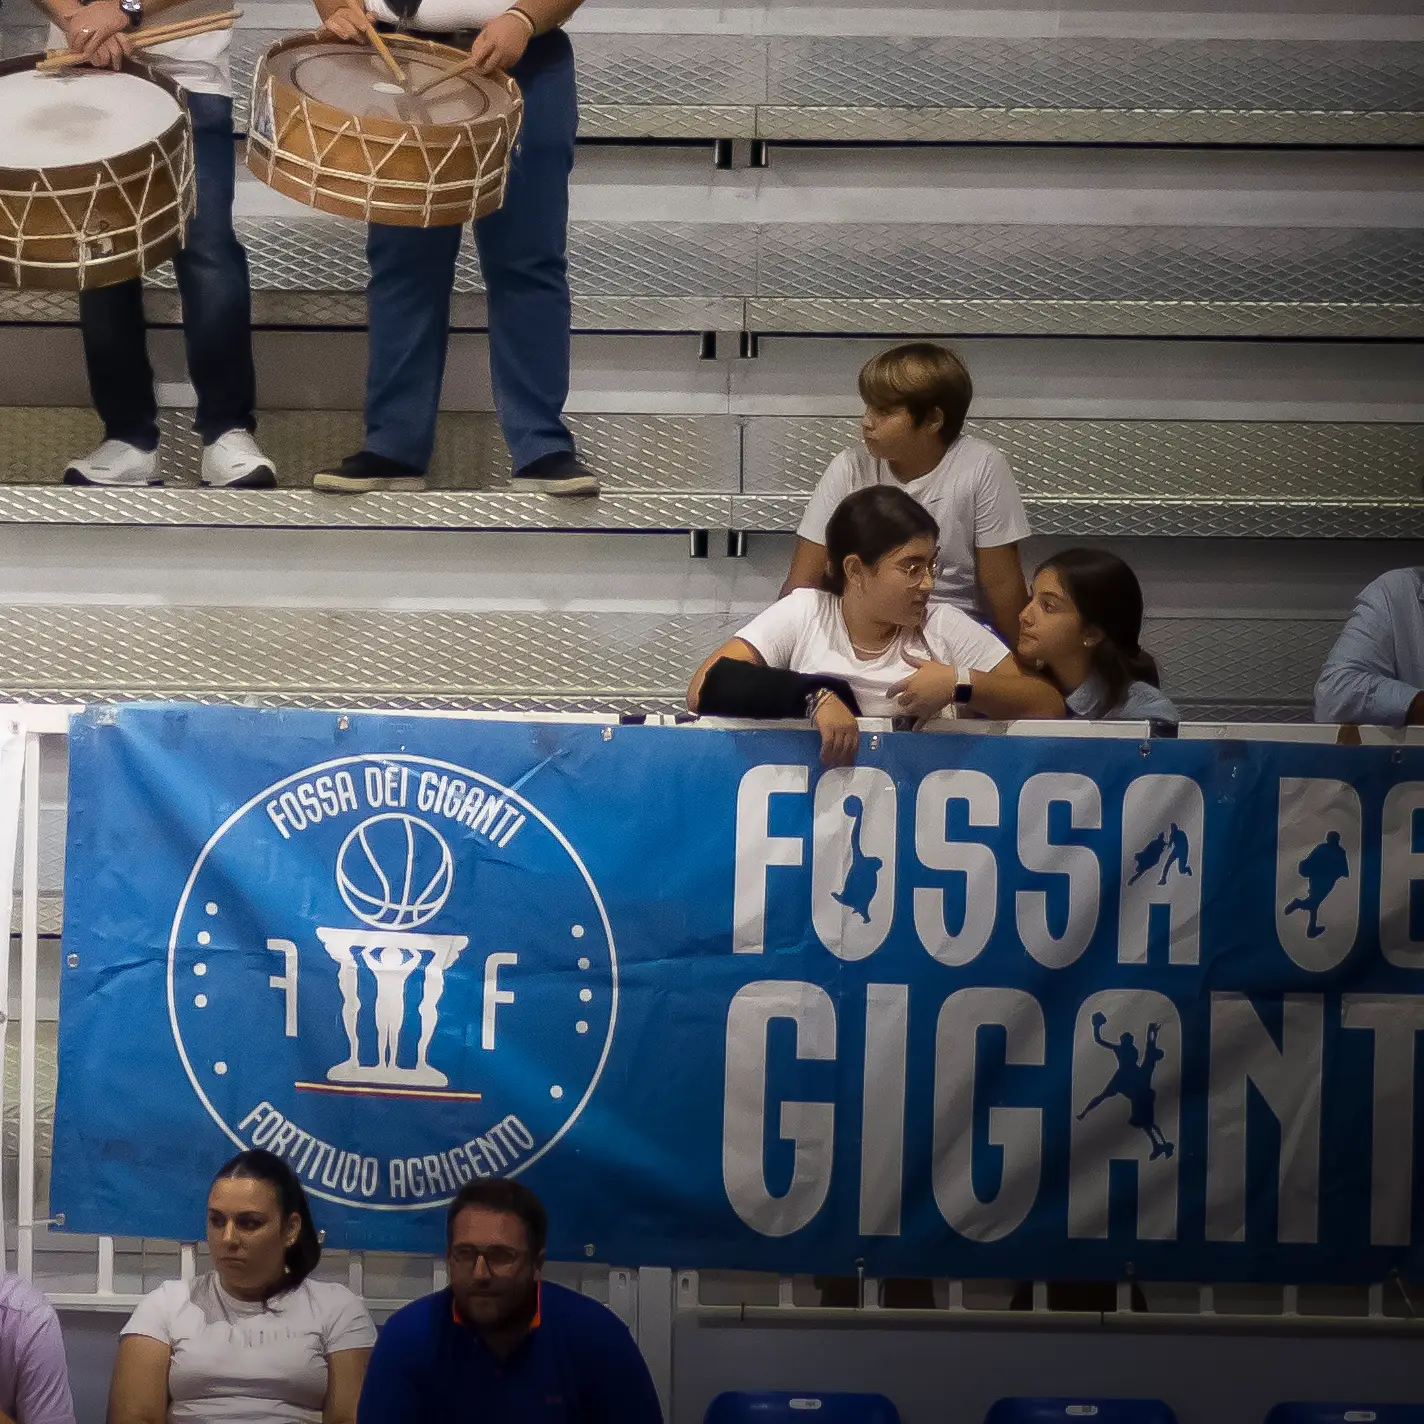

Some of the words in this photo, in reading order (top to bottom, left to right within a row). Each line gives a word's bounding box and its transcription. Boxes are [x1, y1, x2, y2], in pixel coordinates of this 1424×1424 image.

[265, 770, 359, 841] FOSSA
[364, 766, 409, 808] DEI
[417, 771, 527, 849] GIGANTI
[732, 763, 1205, 969] FOSSA
[481, 952, 519, 1051] F
[238, 1100, 379, 1197] FORTITUDO
[389, 1113, 535, 1198] AGRIGENTO
[722, 978, 1424, 1247] GIGANT
